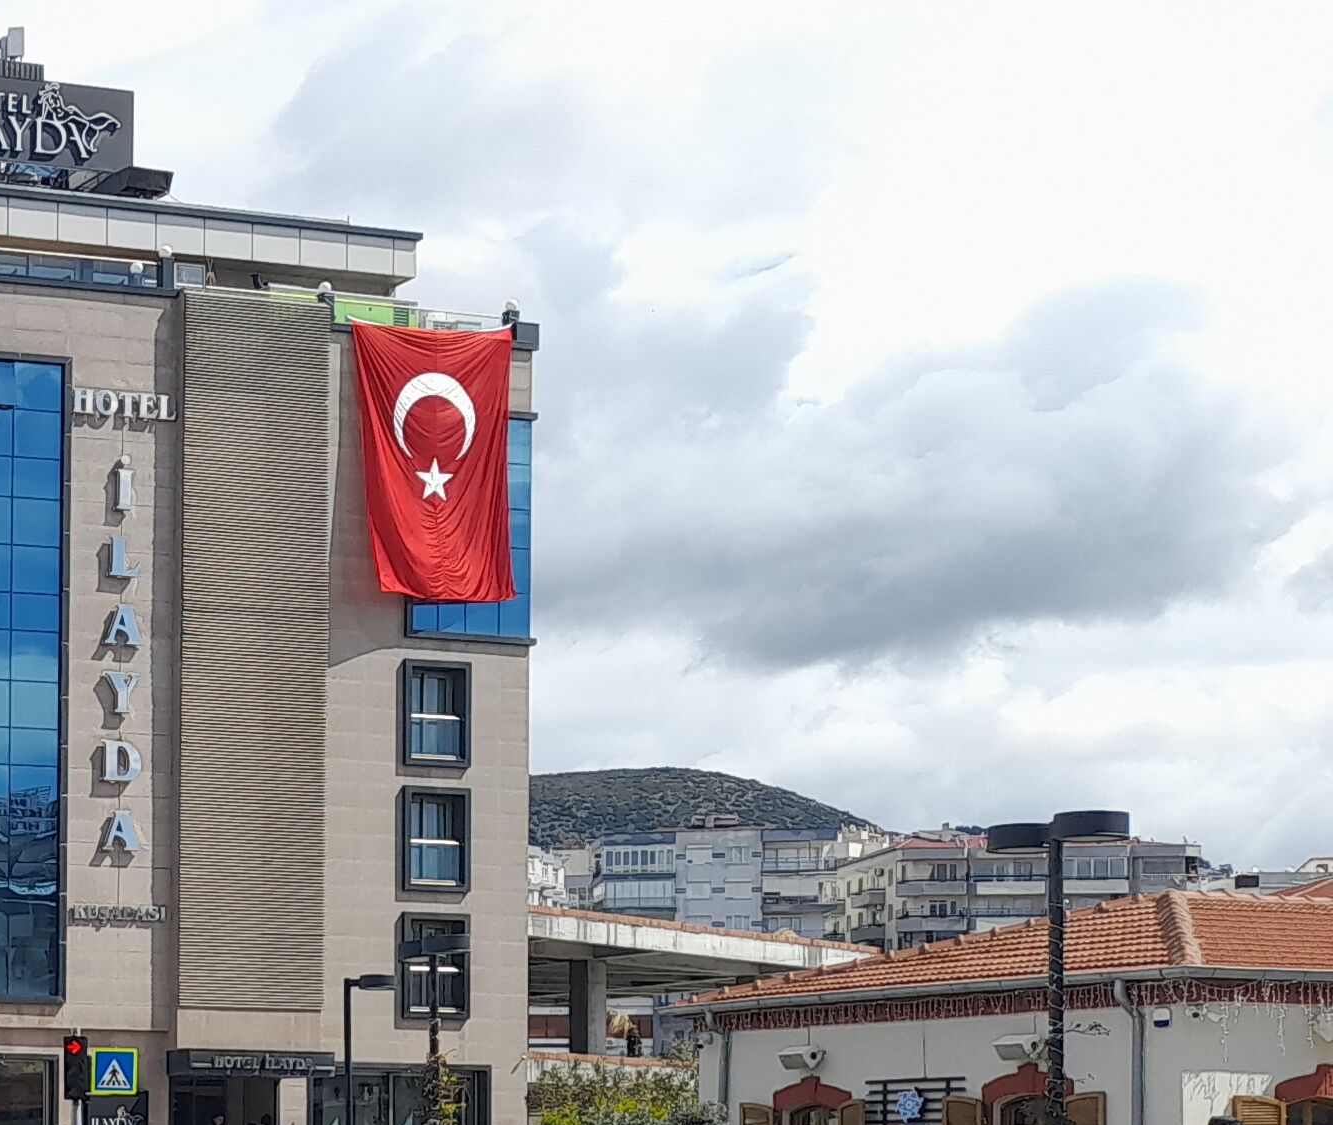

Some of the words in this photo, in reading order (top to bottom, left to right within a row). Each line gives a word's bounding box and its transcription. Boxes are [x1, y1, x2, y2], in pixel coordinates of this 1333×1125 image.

[73, 387, 177, 422] HOTEL
[73, 904, 166, 925] KUŞADASI
[214, 1055, 262, 1069] HOTEL
